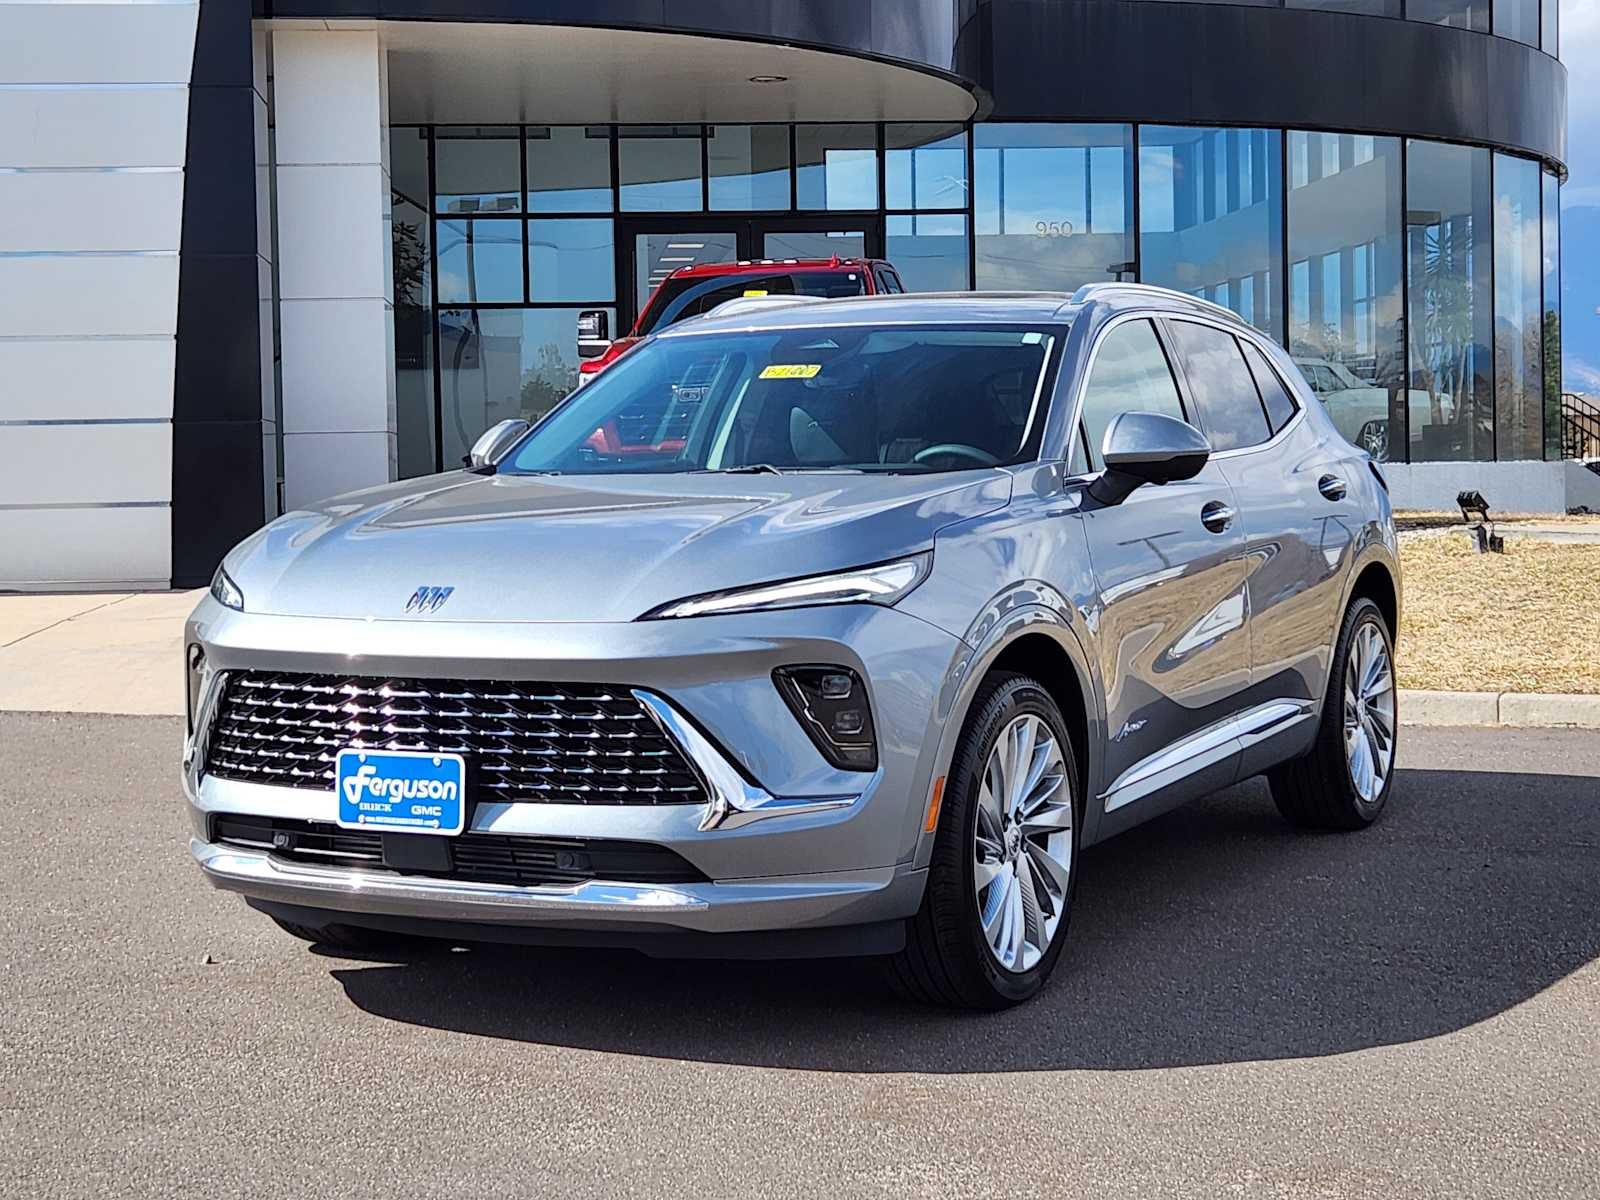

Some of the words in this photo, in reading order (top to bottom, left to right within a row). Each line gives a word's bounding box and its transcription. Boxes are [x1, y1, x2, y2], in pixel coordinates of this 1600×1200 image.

[1035, 221, 1073, 238] 950
[343, 765, 457, 804] Ferguson
[359, 802, 392, 812] BUICK
[411, 805, 442, 816] GMC
